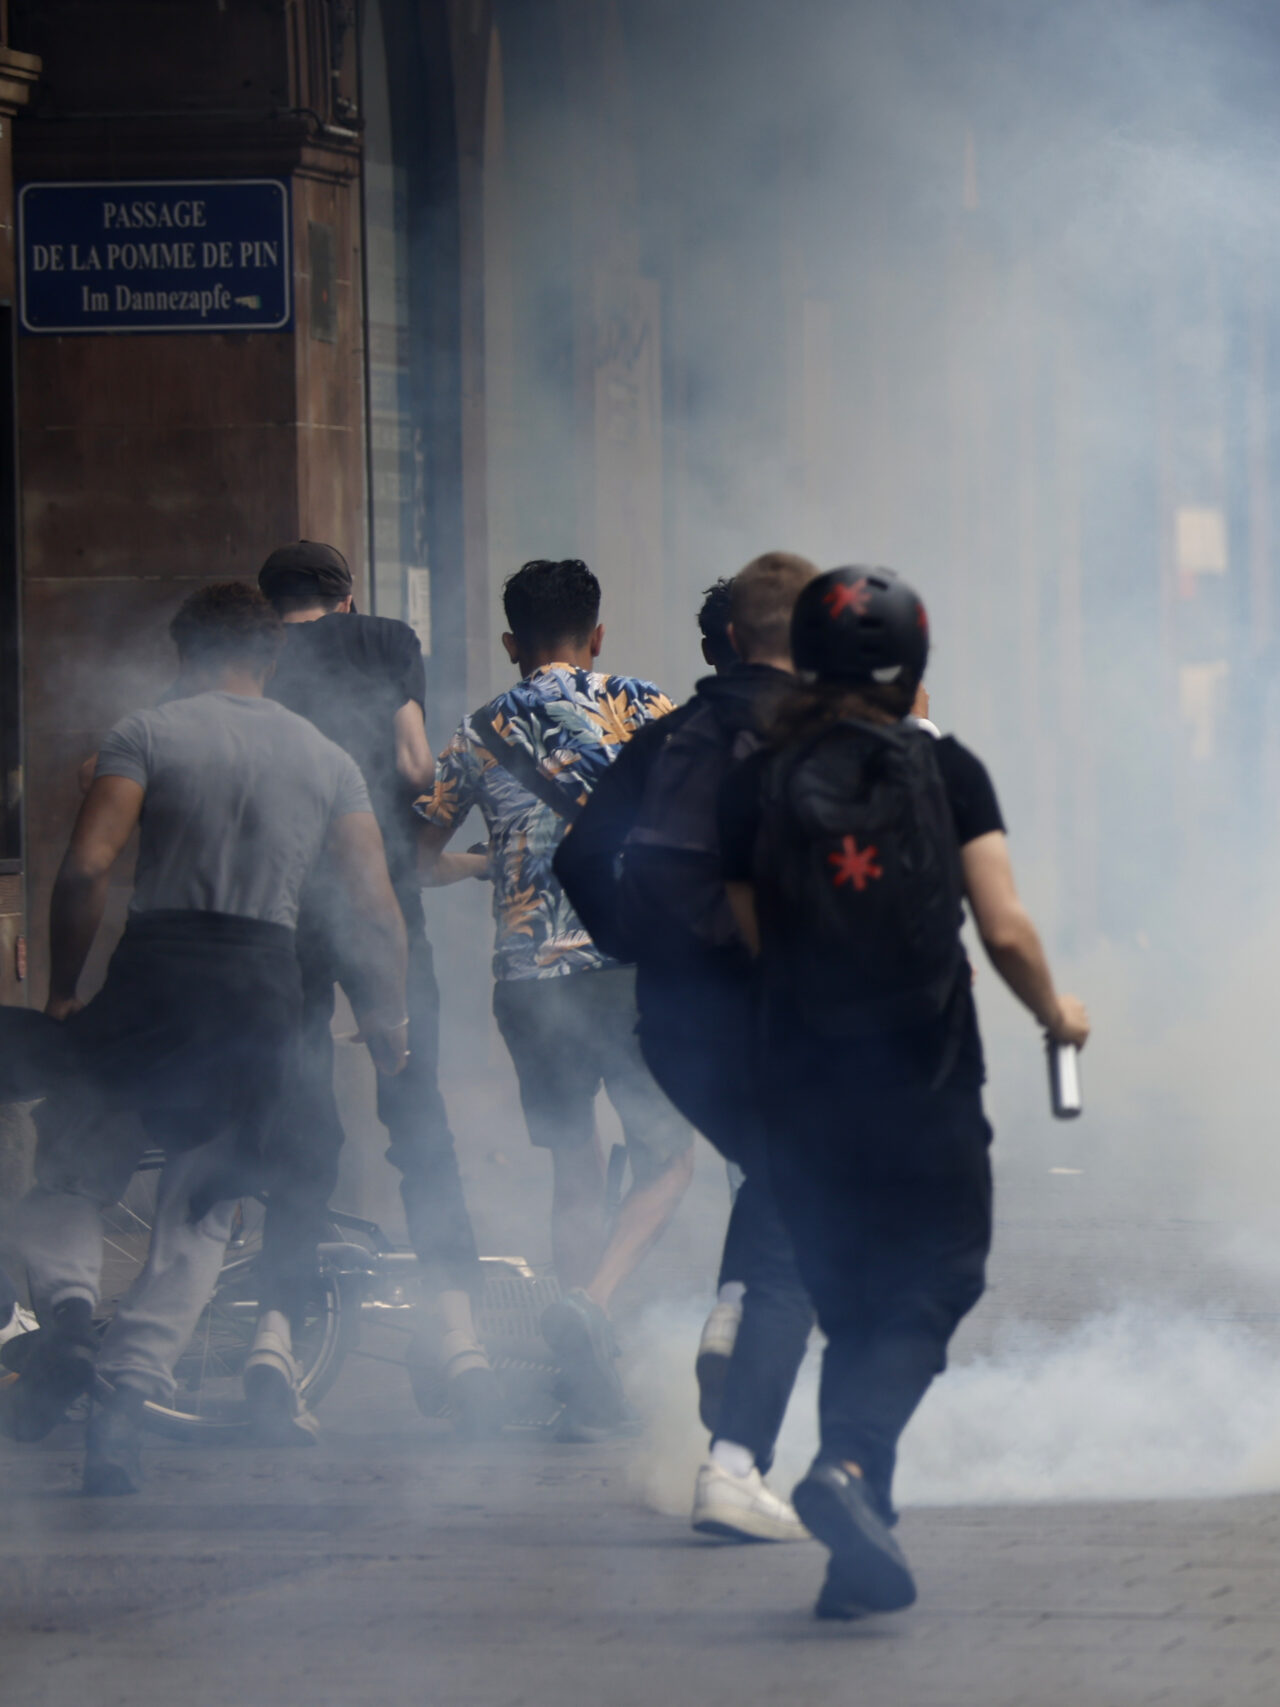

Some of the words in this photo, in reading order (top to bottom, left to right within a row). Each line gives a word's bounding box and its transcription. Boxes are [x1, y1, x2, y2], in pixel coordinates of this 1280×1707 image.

[103, 201, 207, 229] PASSAGE
[32, 245, 64, 272] DE
[70, 245, 102, 271] LA
[107, 243, 196, 270] POMME
[201, 242, 233, 268] DE
[239, 241, 279, 267] PIN
[81, 285, 109, 312] Im
[115, 283, 231, 317] Dannezapfe
